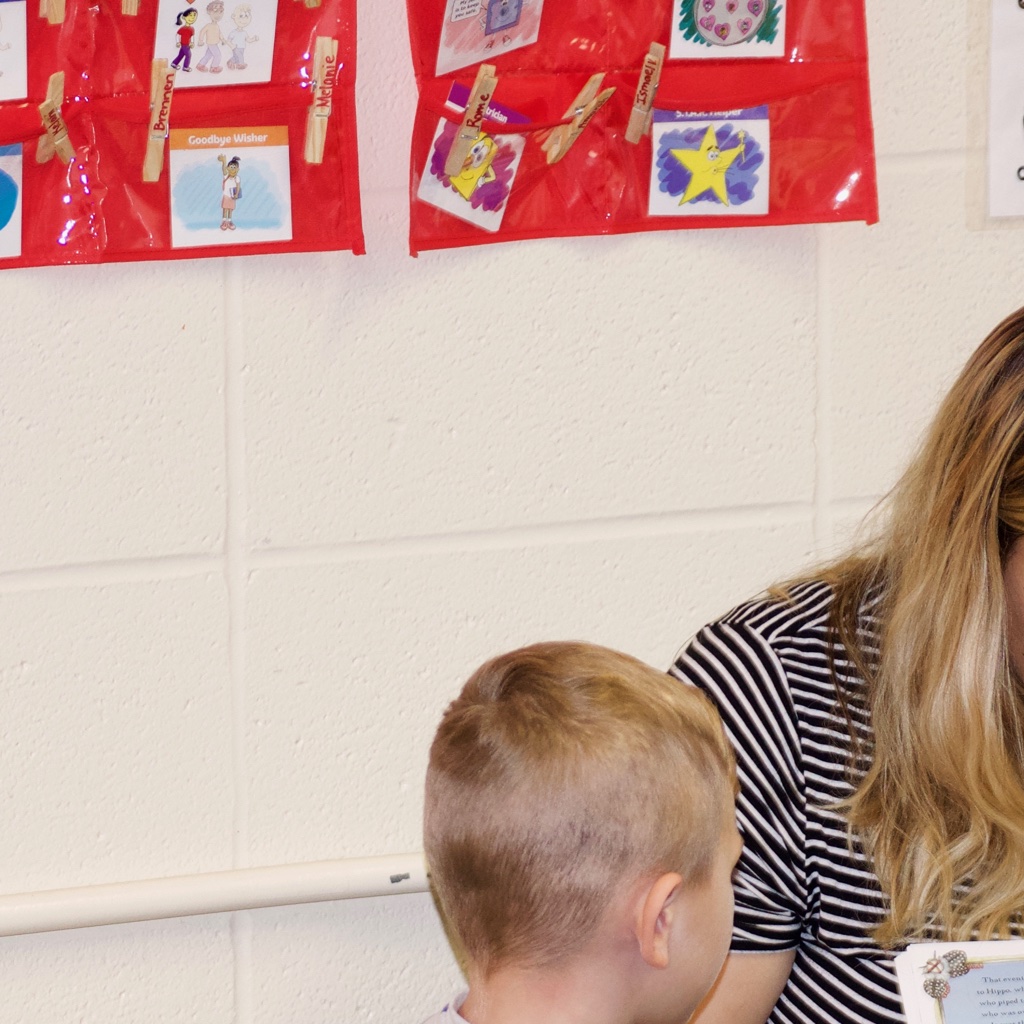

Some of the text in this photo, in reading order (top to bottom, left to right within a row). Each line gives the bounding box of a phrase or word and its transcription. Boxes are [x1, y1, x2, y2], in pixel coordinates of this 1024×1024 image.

[154, 73, 174, 131] Brennen
[485, 105, 508, 124] trician
[188, 133, 268, 147] Goodbye Wisher
[999, 998, 1018, 1006] piped
